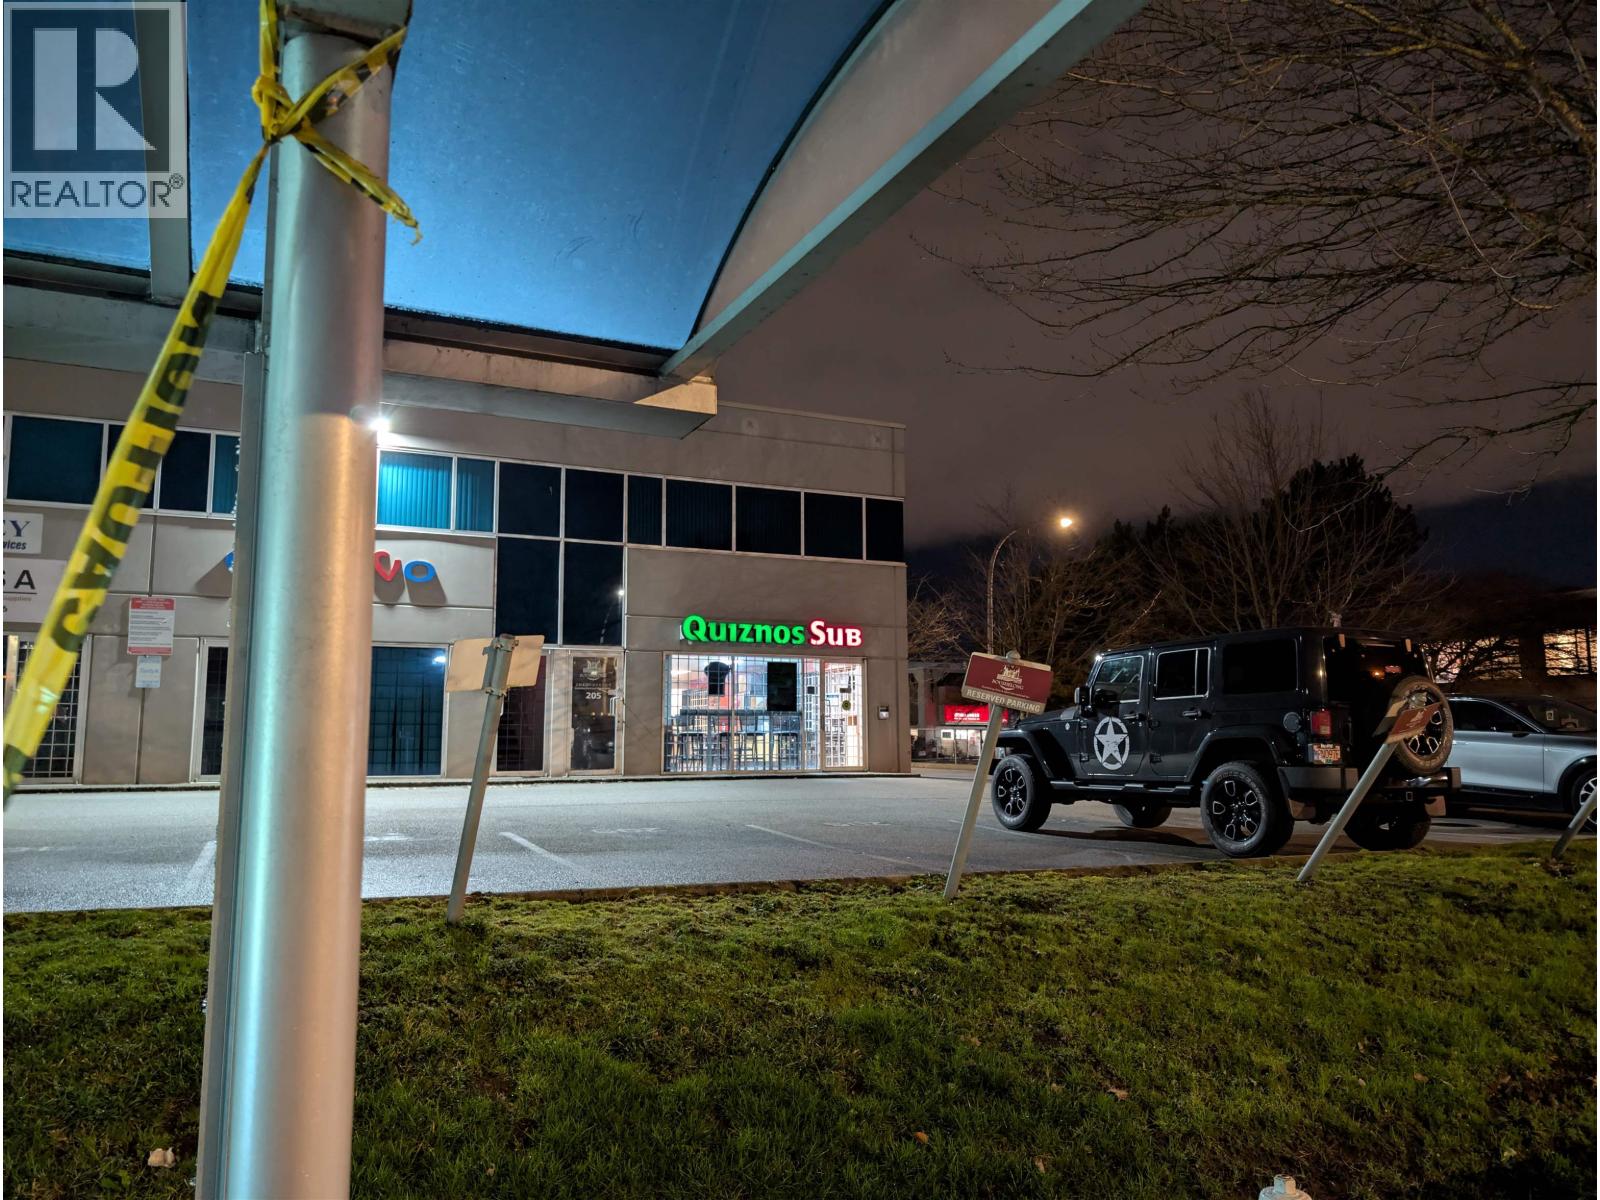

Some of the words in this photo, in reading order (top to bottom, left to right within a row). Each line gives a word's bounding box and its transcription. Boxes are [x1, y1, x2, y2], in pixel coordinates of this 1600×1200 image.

[3, 519, 31, 537] Y
[3, 569, 36, 590] A
[585, 691, 602, 700] 205
[966, 689, 1005, 704] RESERVED
[1006, 698, 1040, 713] PARKING
